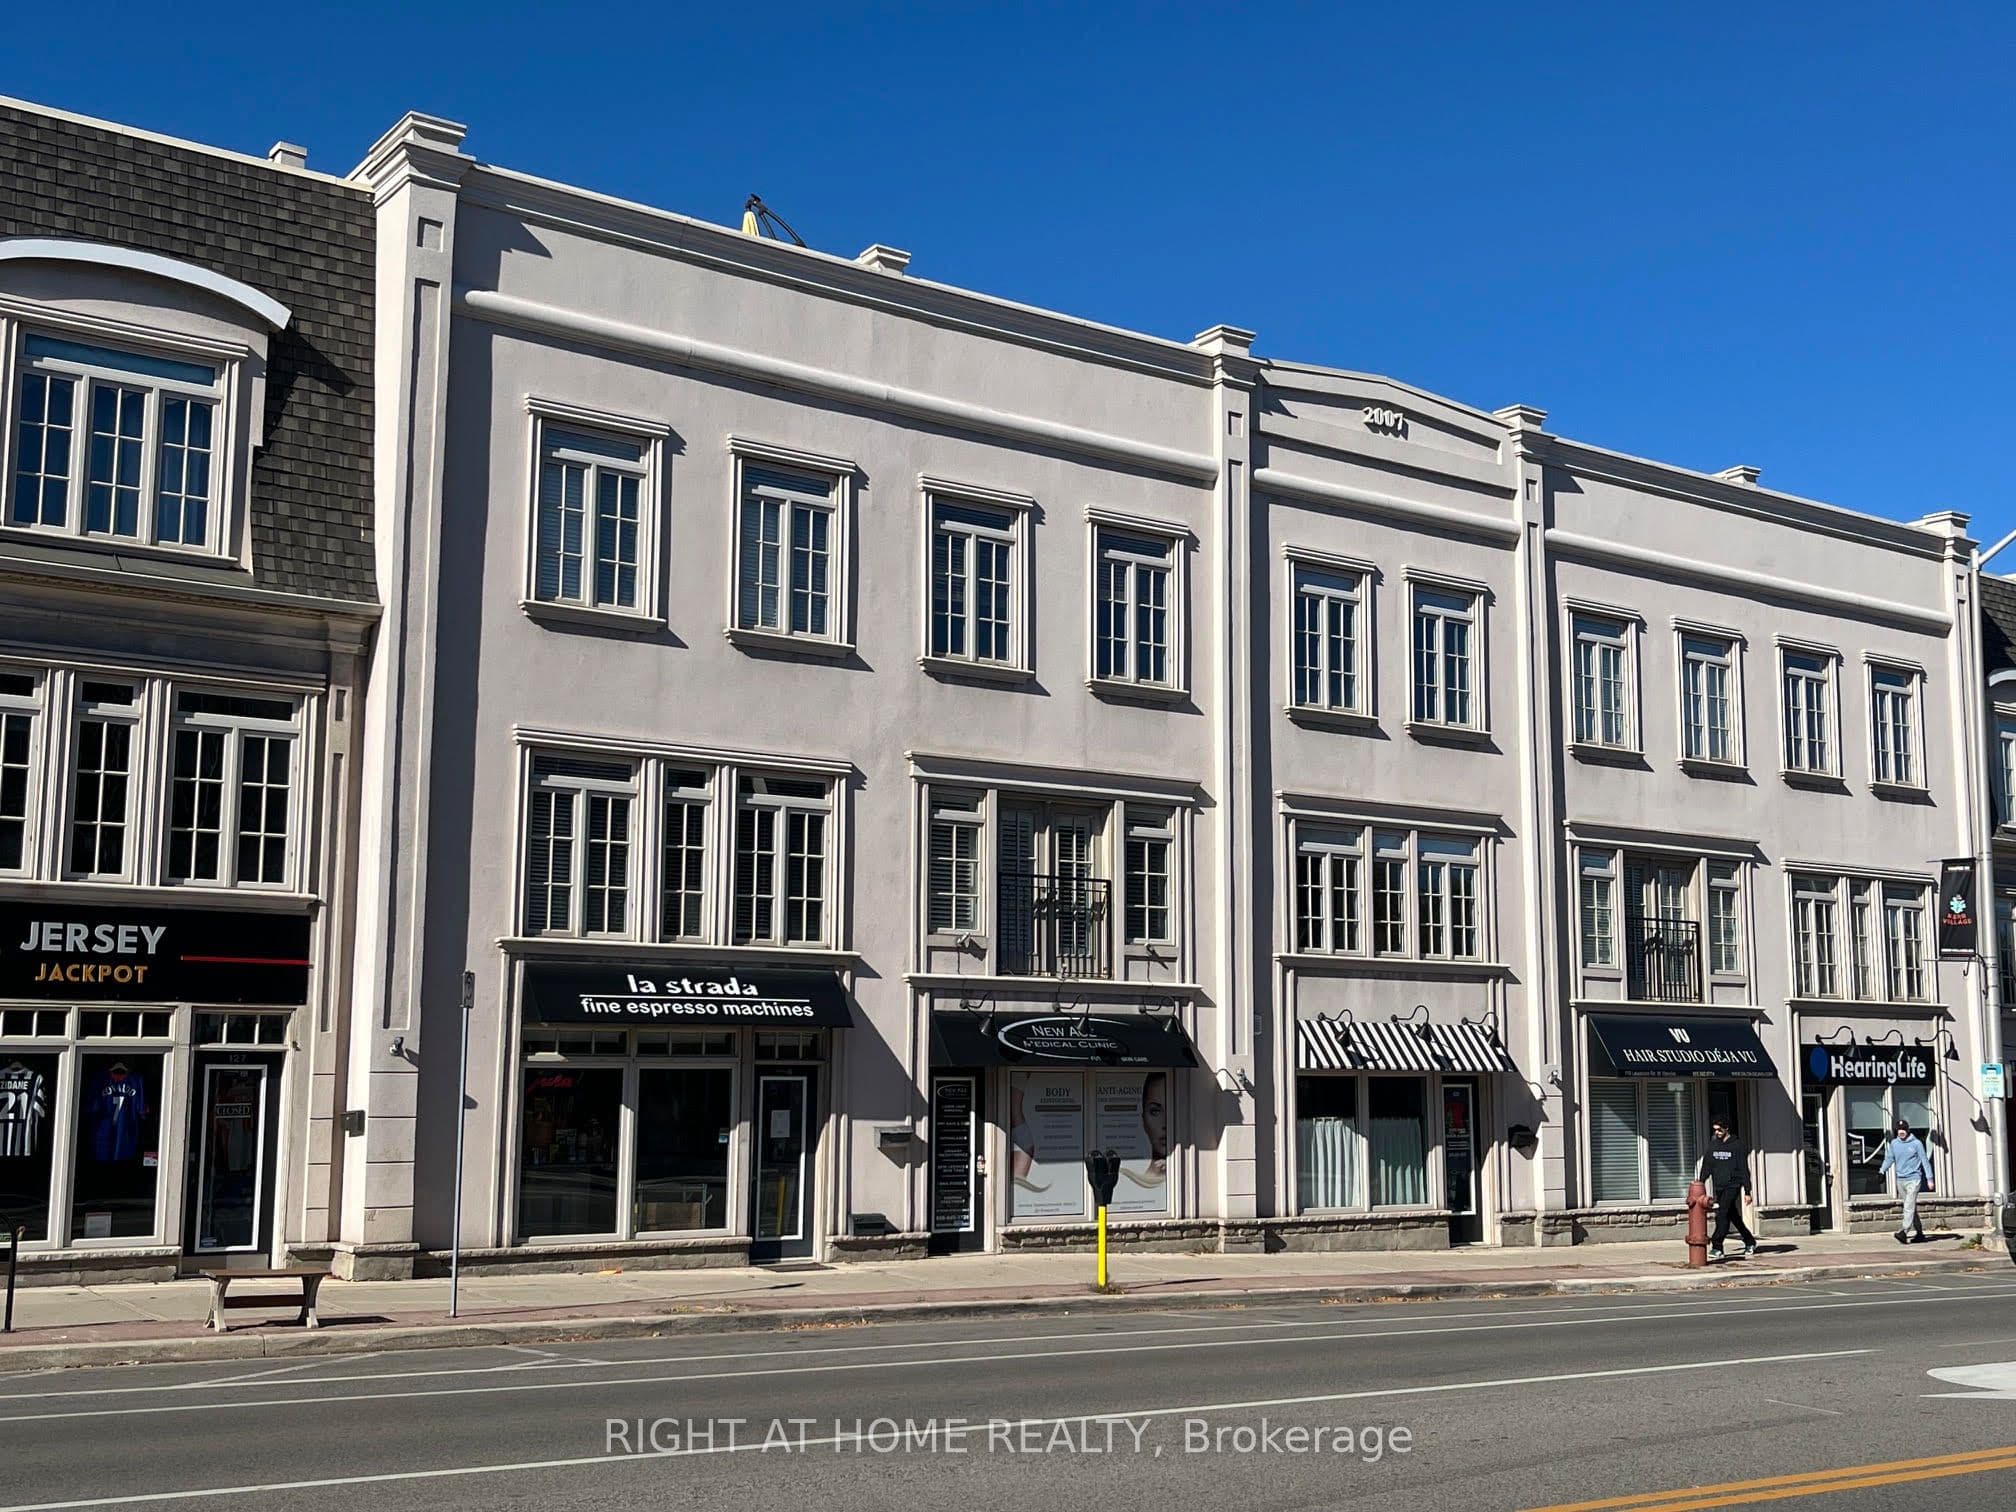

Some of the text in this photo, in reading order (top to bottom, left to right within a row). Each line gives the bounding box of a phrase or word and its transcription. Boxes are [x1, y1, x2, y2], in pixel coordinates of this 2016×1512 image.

[1363, 406, 1404, 431] 2007
[20, 921, 167, 955] JERSEY
[34, 962, 148, 984] JACKPOT
[627, 974, 759, 996] la strada
[581, 998, 814, 1017] fine espresso machines
[1031, 1025, 1065, 1037] NEW
[1668, 1027, 1690, 1043] VU
[1078, 1040, 1118, 1049] CLINIC
[1622, 1049, 1658, 1063] HAIR
[1656, 1049, 1705, 1063] STUDIO
[1738, 1050, 1757, 1063] VU
[1830, 1051, 1927, 1084] HearingLife
[0, 1080, 29, 1090] ZIDANE
[1045, 1087, 1071, 1097] BODY
[1096, 1086, 1142, 1096] ANTI-AGING
[0, 1091, 29, 1120] 21
[112, 1096, 125, 1122] 7
